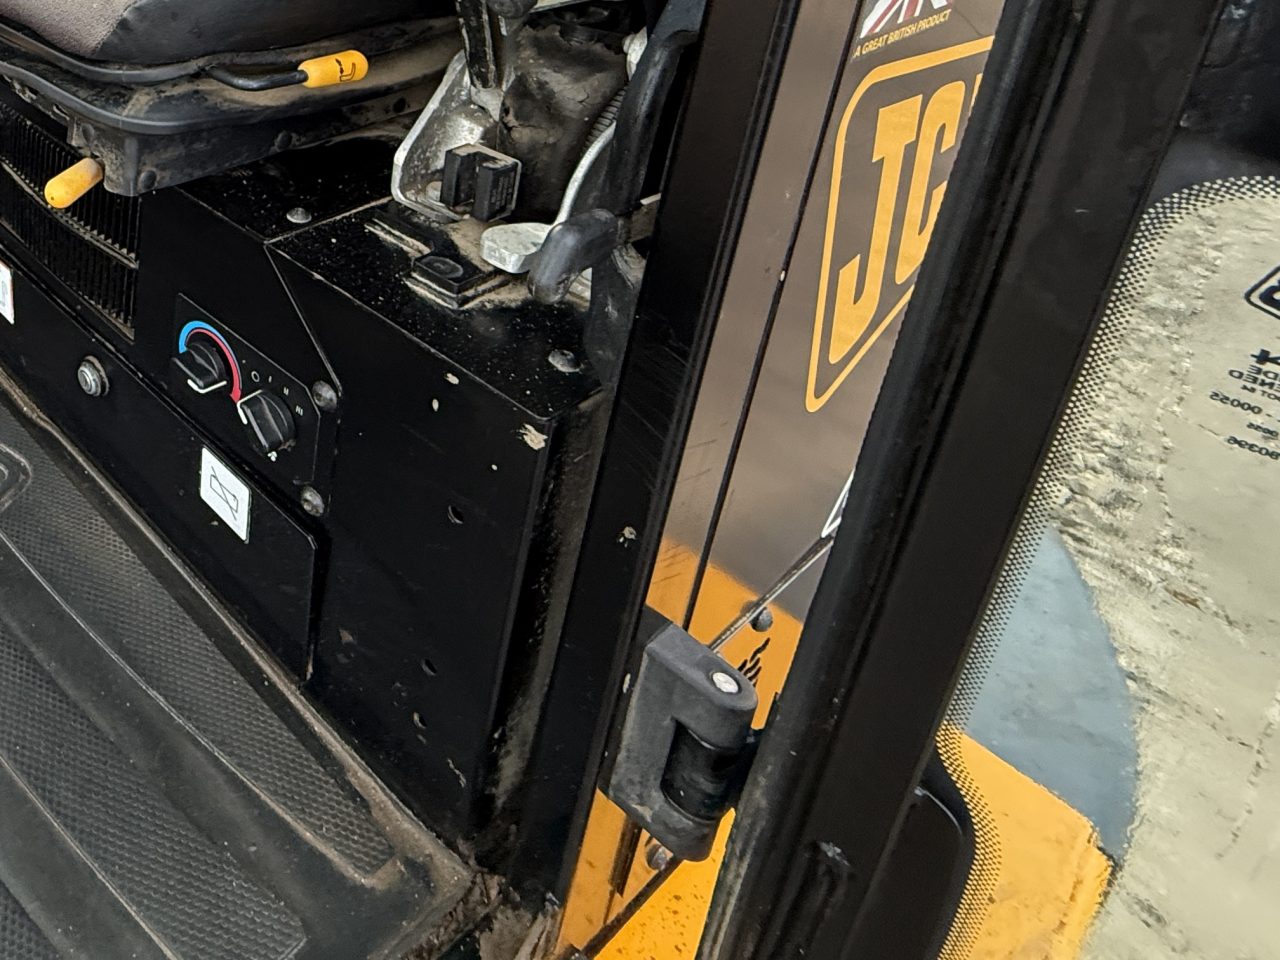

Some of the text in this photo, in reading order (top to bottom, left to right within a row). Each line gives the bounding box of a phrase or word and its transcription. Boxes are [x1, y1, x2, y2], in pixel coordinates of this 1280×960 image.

[862, 34, 889, 55] GREAT
[887, 22, 920, 44] BRITISH
[917, 8, 952, 31] PRODUCT
[829, 73, 983, 364] JC
